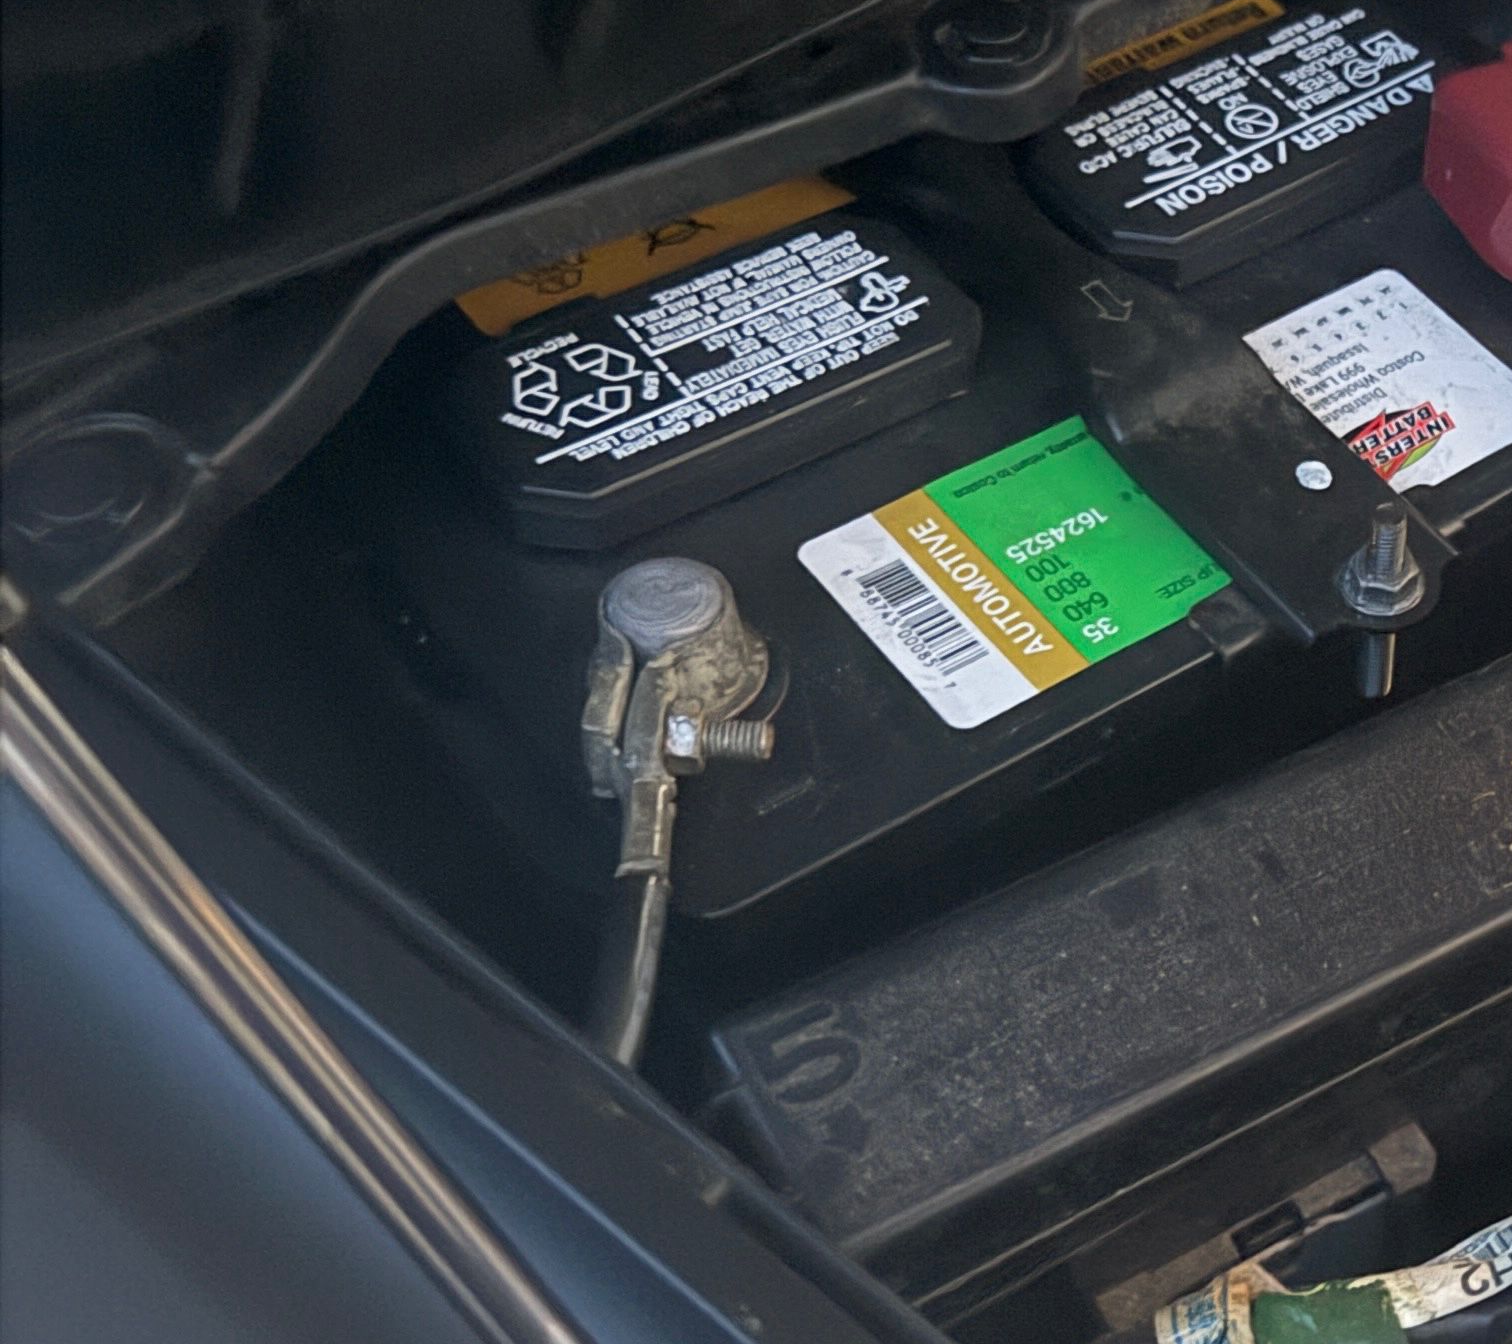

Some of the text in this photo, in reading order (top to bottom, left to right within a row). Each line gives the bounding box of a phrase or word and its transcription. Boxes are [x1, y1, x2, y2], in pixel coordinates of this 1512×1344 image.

[1294, 33, 1345, 62] GASES
[1280, 44, 1357, 85] EXPLOSIVE
[1295, 70, 1337, 94] EYES
[1215, 90, 1249, 111] NO
[1295, 81, 1349, 111] SHIELD
[1105, 108, 1179, 147] CAN CAUSE
[1293, 88, 1411, 149] DANGER
[1072, 131, 1099, 148] OR
[1076, 118, 1190, 176] SULFURIC ACID
[1157, 154, 1271, 214] POISON
[806, 242, 862, 270] FOLLOW
[699, 282, 730, 300] NOT
[752, 286, 788, 306] SAFE
[786, 275, 817, 292] FOR
[700, 287, 840, 351] MEDICAL HELP FAST
[715, 300, 754, 321] JUMP
[811, 299, 853, 323] WITH
[891, 309, 919, 325] DO
[860, 321, 894, 340] NOT
[505, 330, 579, 368] RECYCLE
[685, 311, 864, 390] FLUSH EYES IMMEDIATELY
[727, 336, 762, 357] GET
[789, 348, 830, 369] KEEP
[824, 348, 861, 369] OUT
[799, 363, 827, 379] OF
[1302, 342, 1368, 379] Issaquah,
[1335, 361, 1366, 381] 999
[748, 364, 790, 387] VENT
[766, 374, 802, 394] THE
[1302, 376, 1339, 398] Lake
[1310, 350, 1425, 412] Costco Wholesale
[704, 382, 749, 405] CAPS
[715, 388, 769, 416] REACH
[1320, 387, 1386, 424] Distribute
[655, 401, 703, 426] TIGHT
[688, 409, 717, 427] OF
[611, 421, 691, 459] CHILDREN
[618, 420, 656, 441] AND
[568, 435, 620, 462] LEVEL
[1004, 504, 1107, 564] 1624525
[1022, 552, 1070, 583] 100
[906, 516, 1054, 657] AUTOMOTIVE
[1041, 570, 1092, 603] 800
[1060, 589, 1111, 623] 640
[1079, 614, 1120, 643] 35
